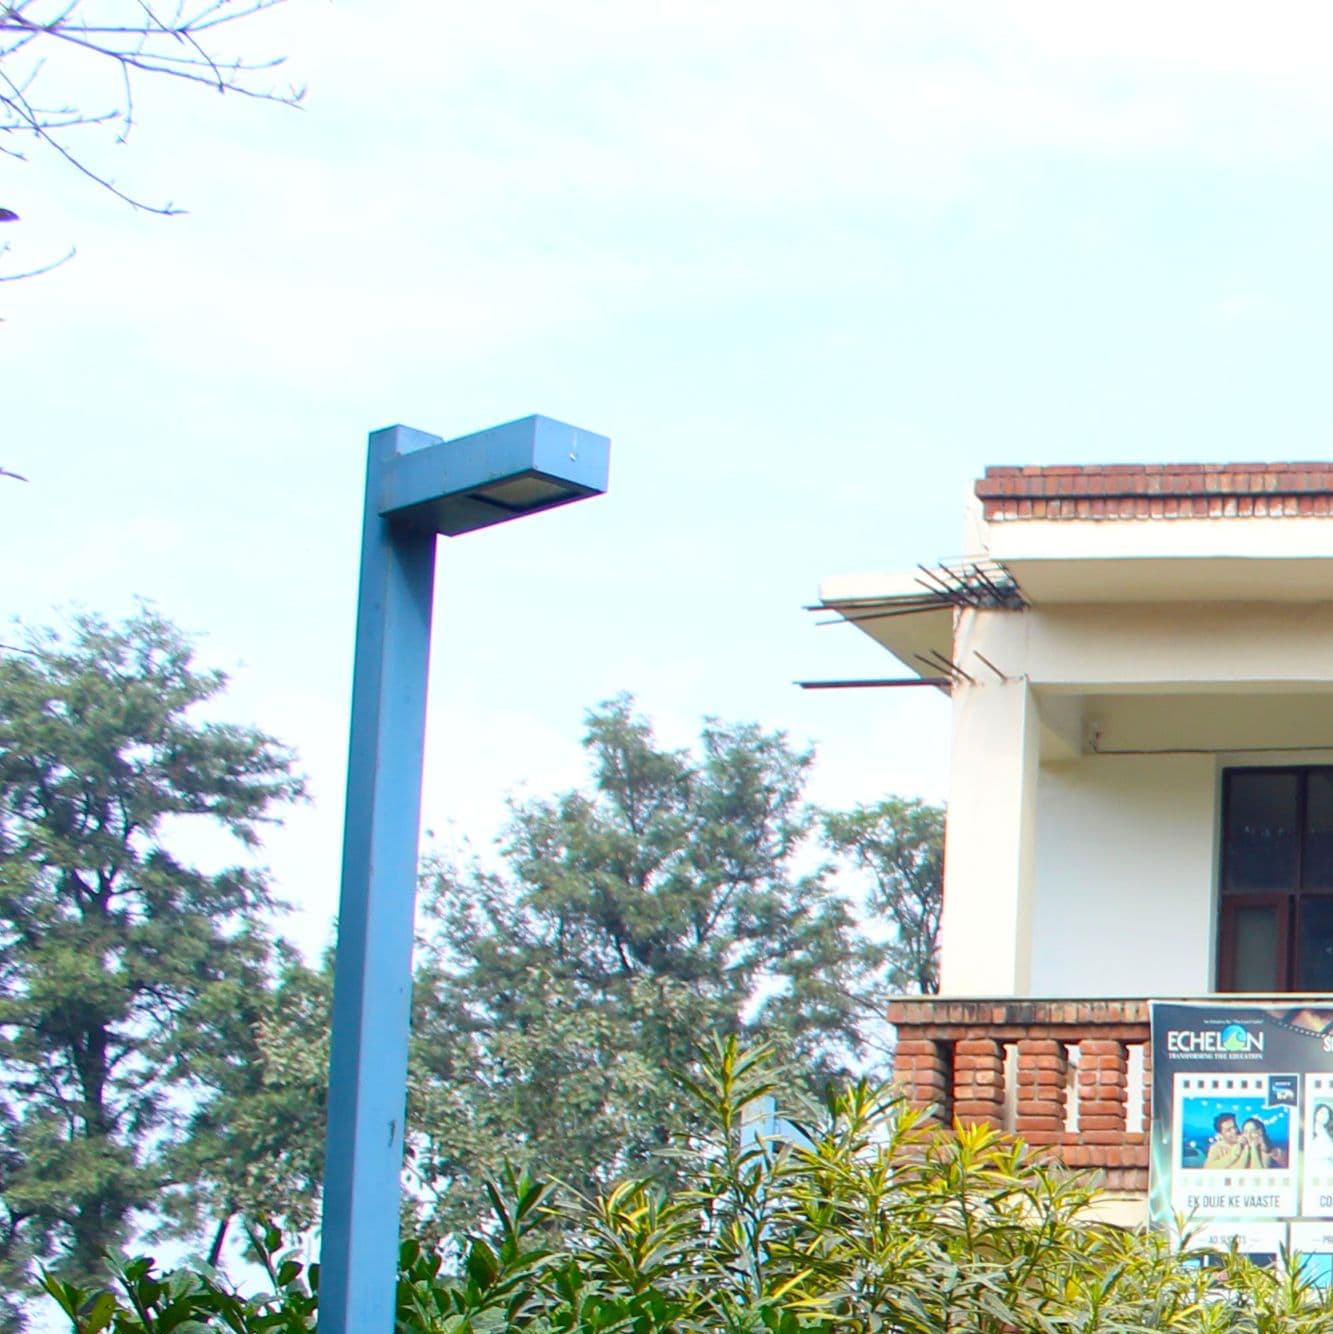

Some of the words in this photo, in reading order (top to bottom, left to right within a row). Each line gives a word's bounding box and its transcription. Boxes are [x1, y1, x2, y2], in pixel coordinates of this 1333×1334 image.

[1167, 1024, 1264, 1051] ECHELON
[1203, 1195, 1225, 1208] DUJE
[1229, 1195, 1240, 1208] KE
[1243, 1195, 1280, 1208] VAASTE
